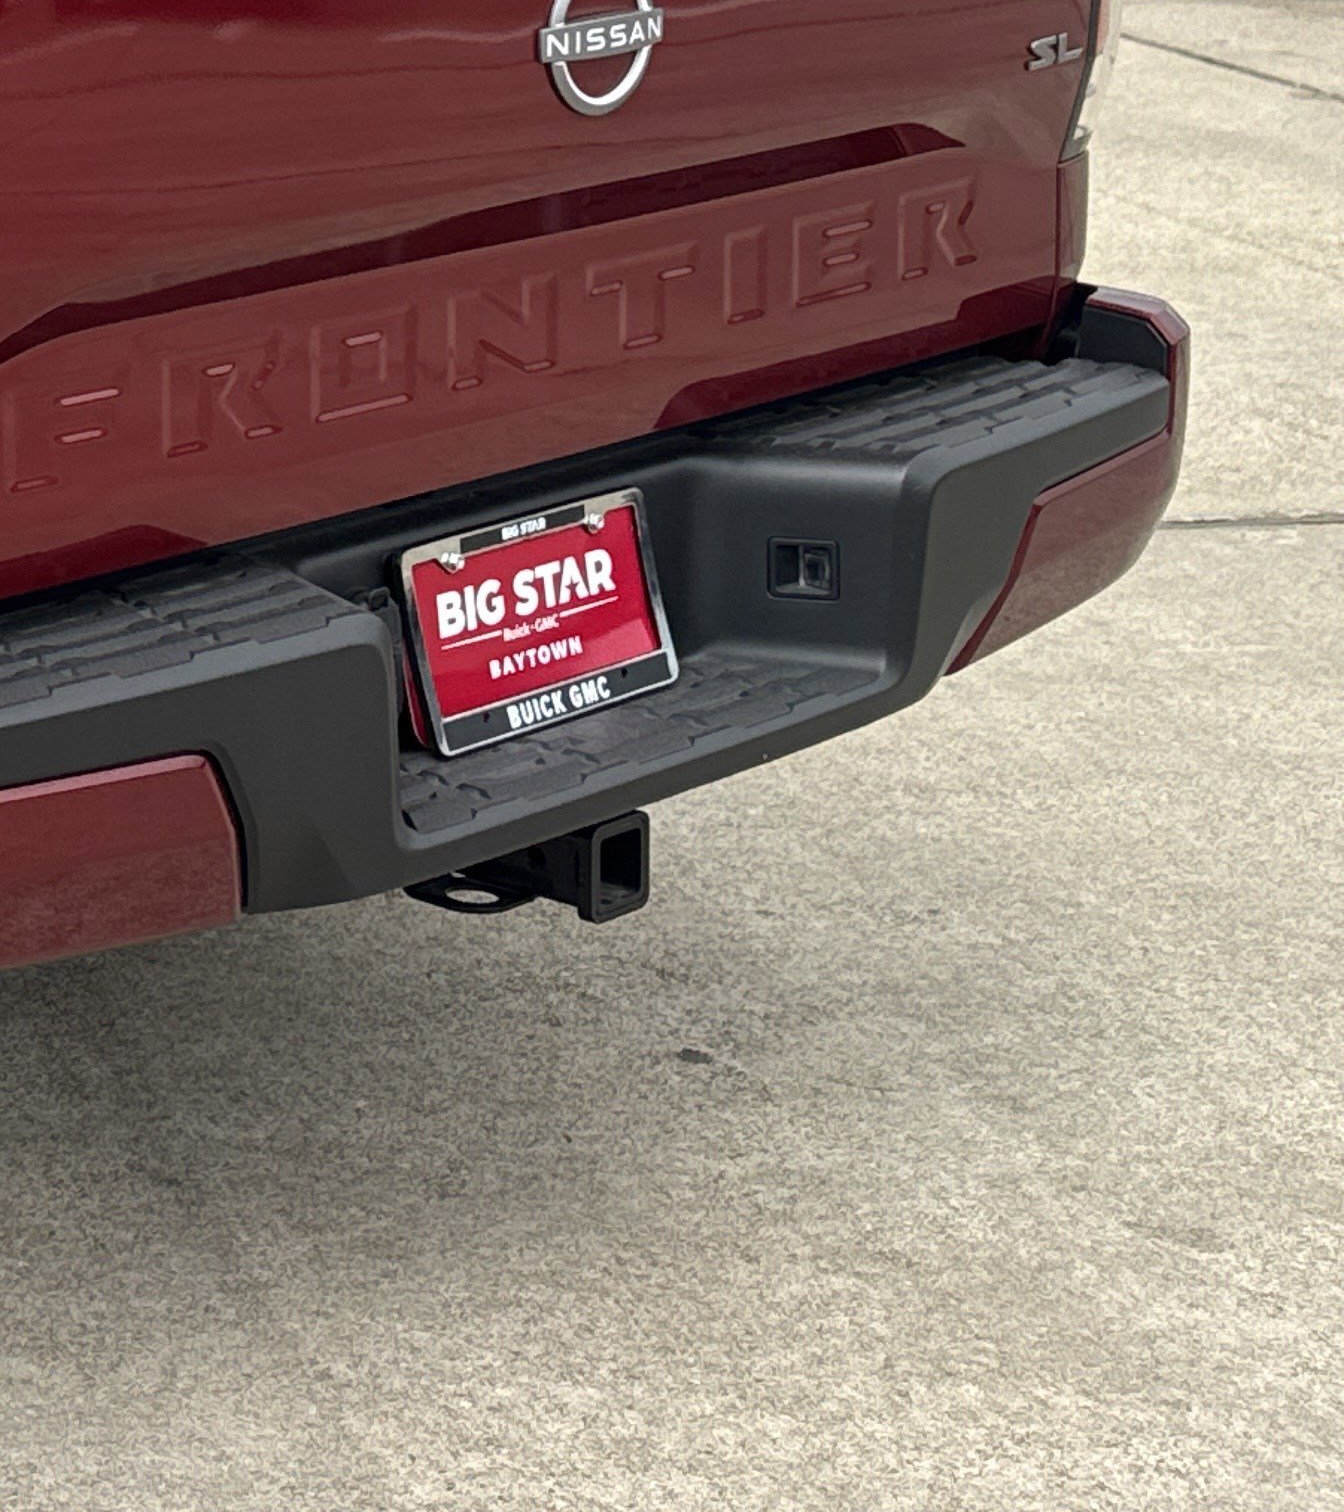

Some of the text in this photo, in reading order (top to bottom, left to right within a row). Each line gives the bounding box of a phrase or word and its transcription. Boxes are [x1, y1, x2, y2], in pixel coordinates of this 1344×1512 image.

[546, 15, 662, 58] NISSAN
[1028, 32, 1084, 71] SL
[2, 175, 979, 493] FRONTIER
[436, 548, 617, 639] BIG STAR
[488, 636, 584, 680] BAYTOWN
[506, 676, 612, 729] BUICK GMC
